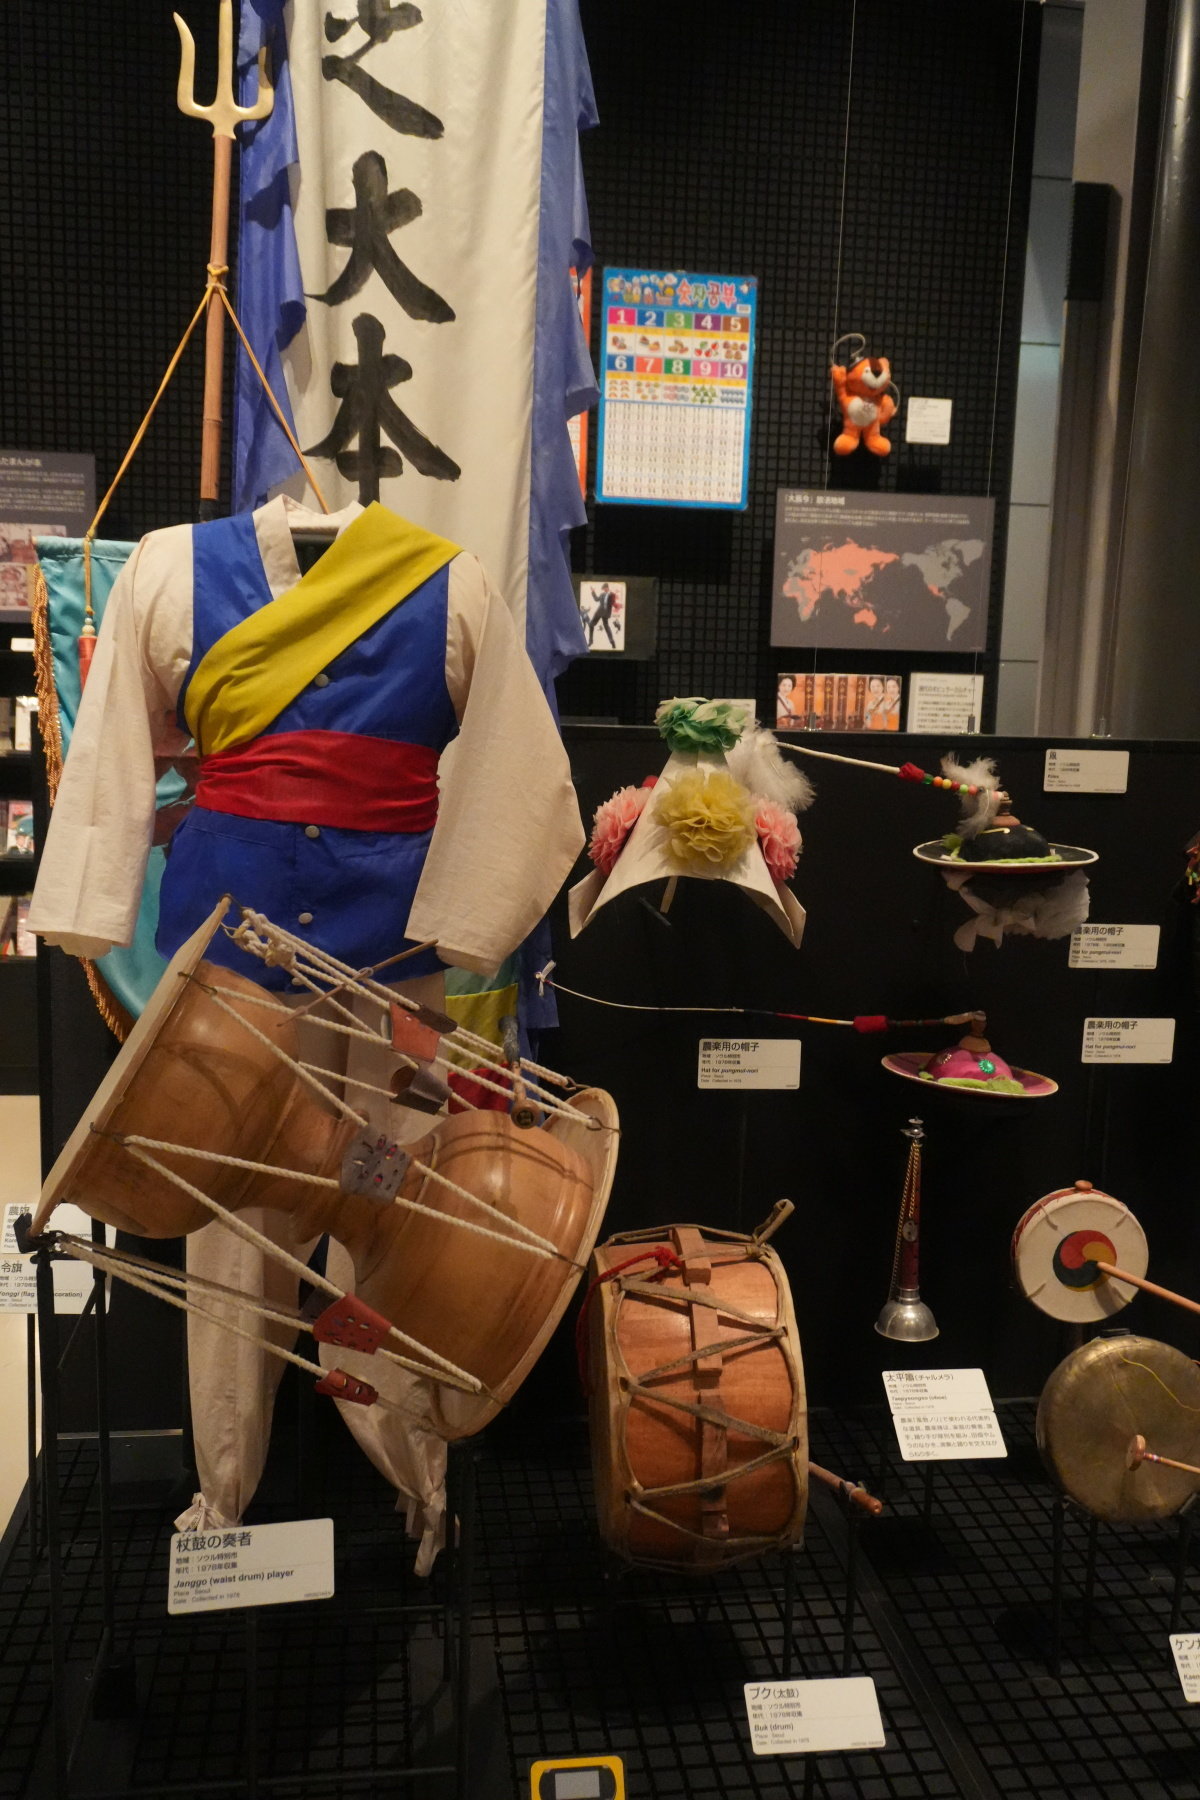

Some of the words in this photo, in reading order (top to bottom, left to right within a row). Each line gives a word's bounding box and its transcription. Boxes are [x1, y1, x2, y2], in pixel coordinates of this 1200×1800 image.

[677, 278, 737, 308] 숫자공부
[616, 309, 627, 324] 1
[645, 311, 657, 326] 2
[673, 313, 685, 327] 3
[701, 315, 713, 330] 4
[730, 317, 742, 331] 5
[615, 356, 627, 370] 6
[643, 358, 655, 372] 7
[672, 360, 684, 374] 8
[700, 362, 712, 376] 9
[724, 363, 743, 377] 10
[176, 1531, 252, 1552] 杖鼓の奏者
[174, 1578, 207, 1589] Janggo
[210, 1575, 236, 1586] (waist
[238, 1571, 265, 1582] drum)
[267, 1569, 294, 1580] player
[754, 1723, 768, 1731] Buk
[770, 1723, 793, 1731] (drum)
